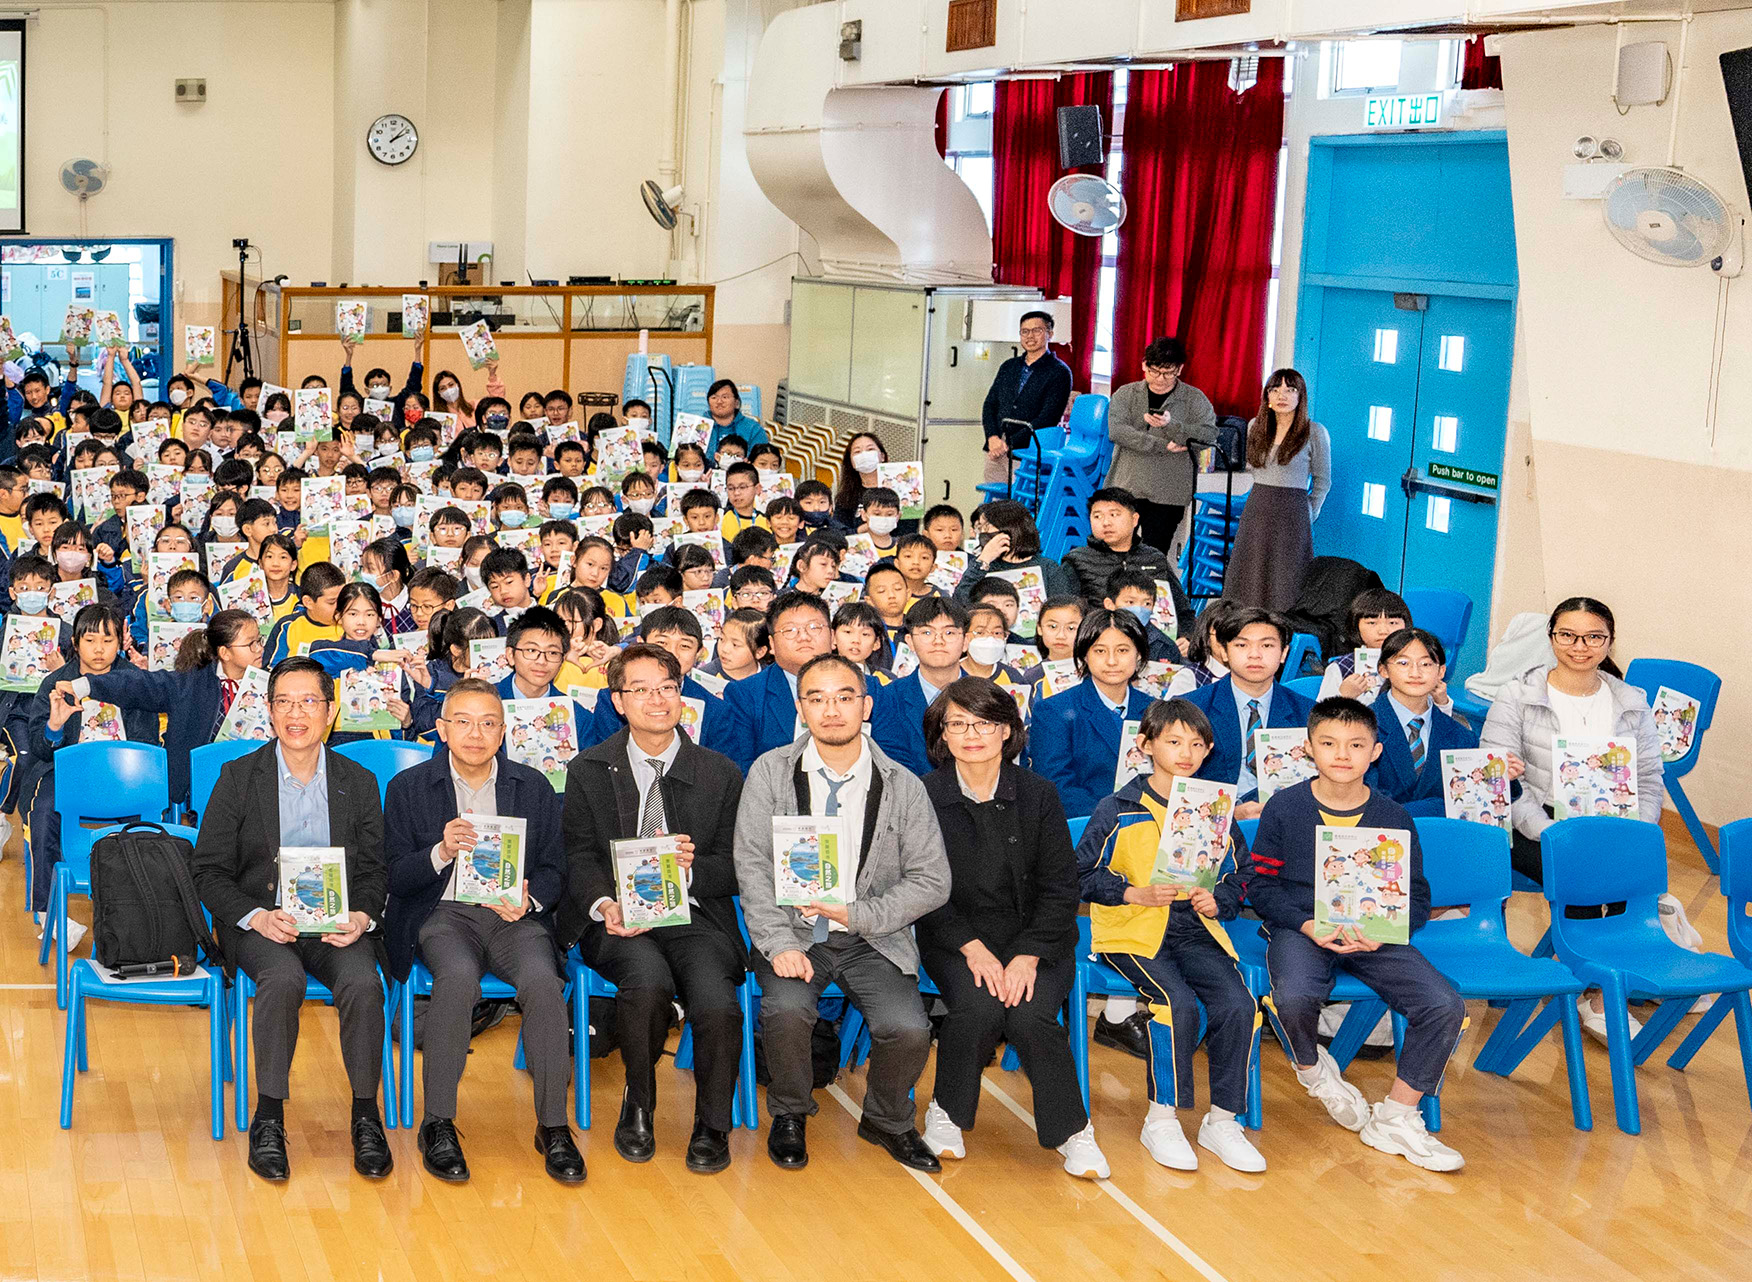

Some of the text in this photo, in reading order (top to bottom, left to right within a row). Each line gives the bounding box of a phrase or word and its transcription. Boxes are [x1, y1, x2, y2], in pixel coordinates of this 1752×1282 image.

[1368, 98, 1406, 126] EXIT
[1409, 96, 1438, 124] 出口
[50, 270, 64, 278] 5C
[1432, 464, 1496, 486] Push bar to open
[1386, 847, 1396, 879] 自然之旅
